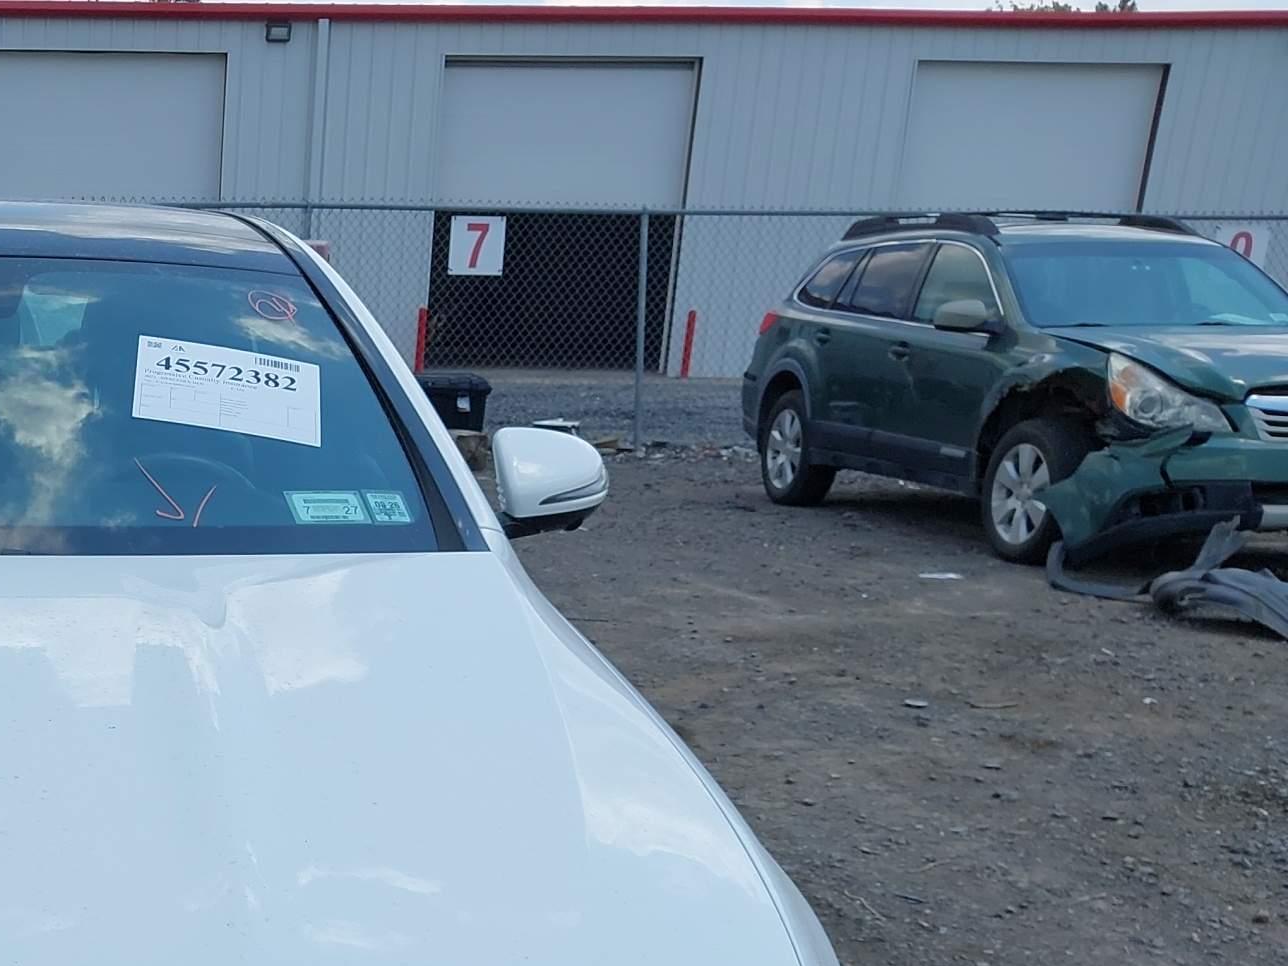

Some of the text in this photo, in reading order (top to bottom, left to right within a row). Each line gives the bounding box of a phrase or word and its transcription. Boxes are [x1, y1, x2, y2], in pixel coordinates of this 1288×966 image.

[467, 223, 490, 268] 7
[156, 356, 297, 391] 45572382
[303, 505, 359, 515] 7 27
